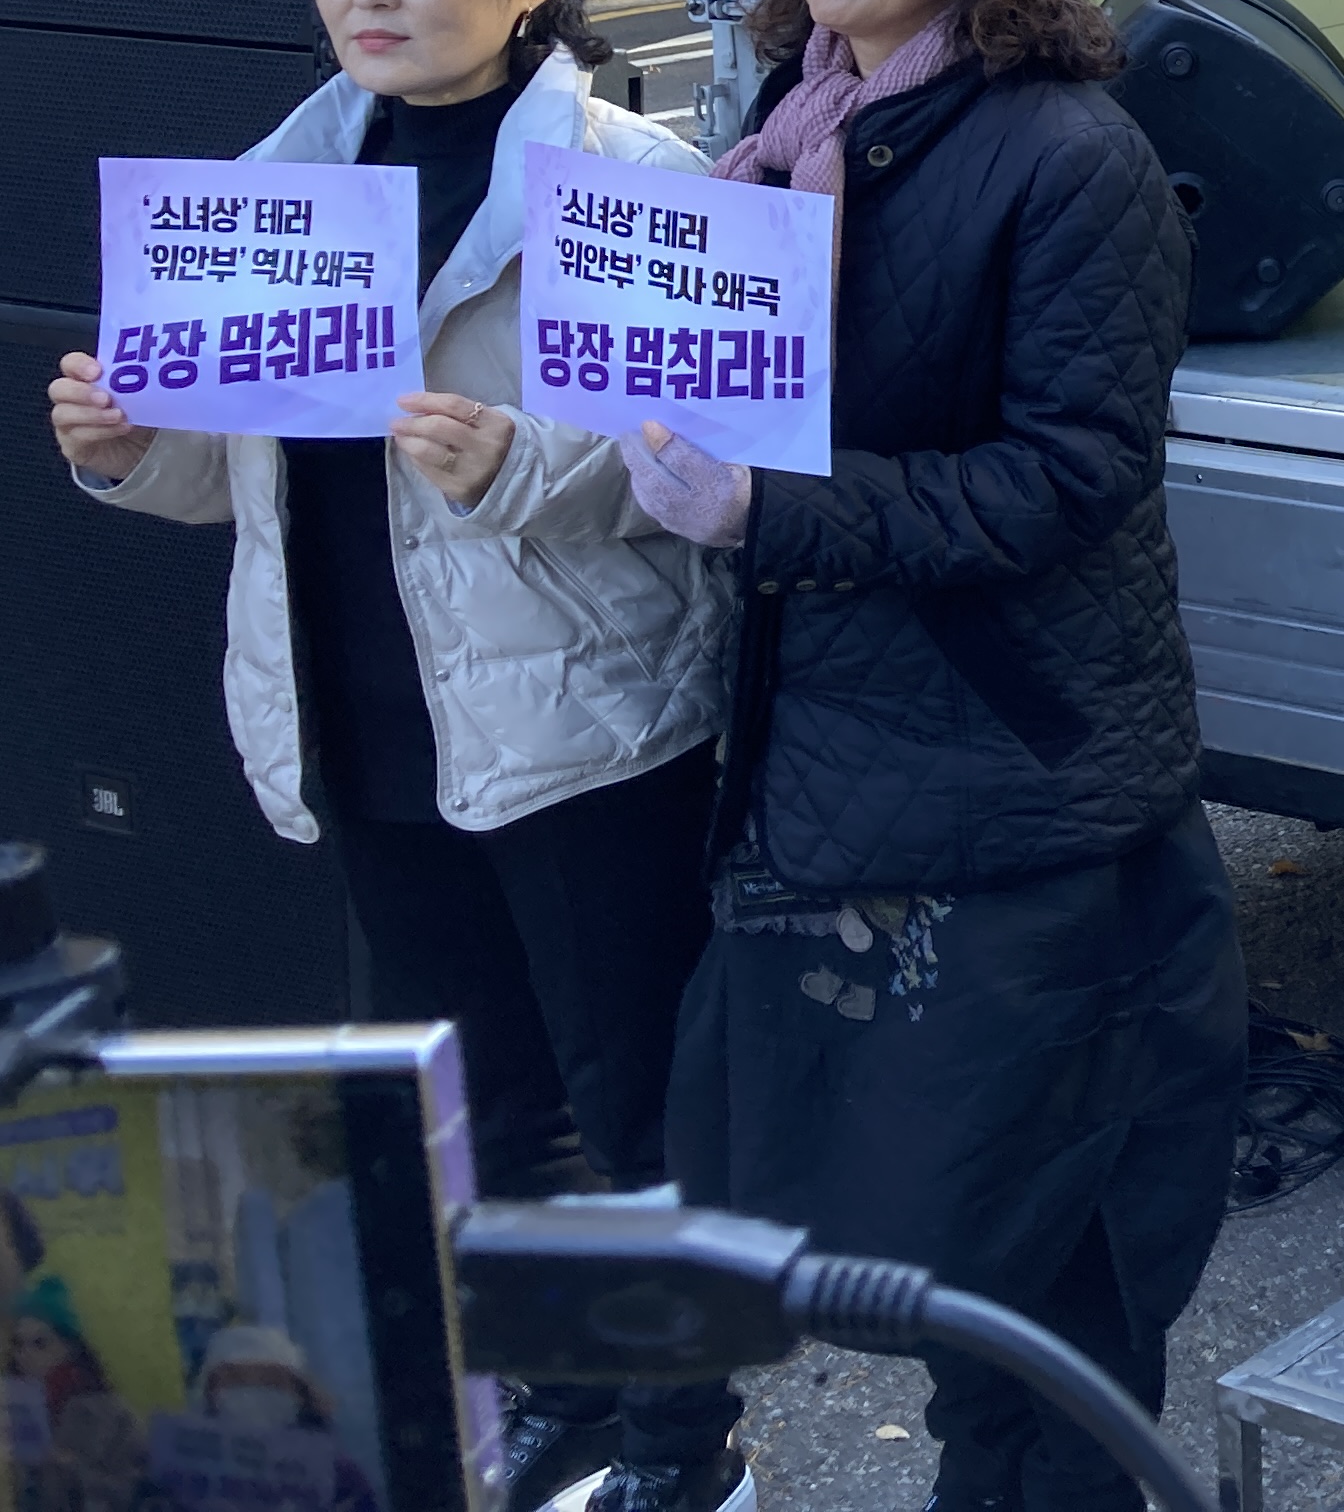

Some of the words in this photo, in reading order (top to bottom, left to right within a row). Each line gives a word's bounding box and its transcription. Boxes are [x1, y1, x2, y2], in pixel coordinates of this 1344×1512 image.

[254, 199, 312, 236] 테러
[648, 206, 708, 254] 테러
[251, 248, 308, 286] 역사
[311, 251, 374, 289] 왜곡
[647, 259, 706, 305] 역사
[711, 271, 781, 317] 왜곡
[109, 319, 206, 394] 당장
[219, 303, 395, 384] 멈춰라!!
[537, 319, 614, 391] 당장
[625, 327, 805, 401] 멈춰라!!
[92, 788, 124, 817] JBL
